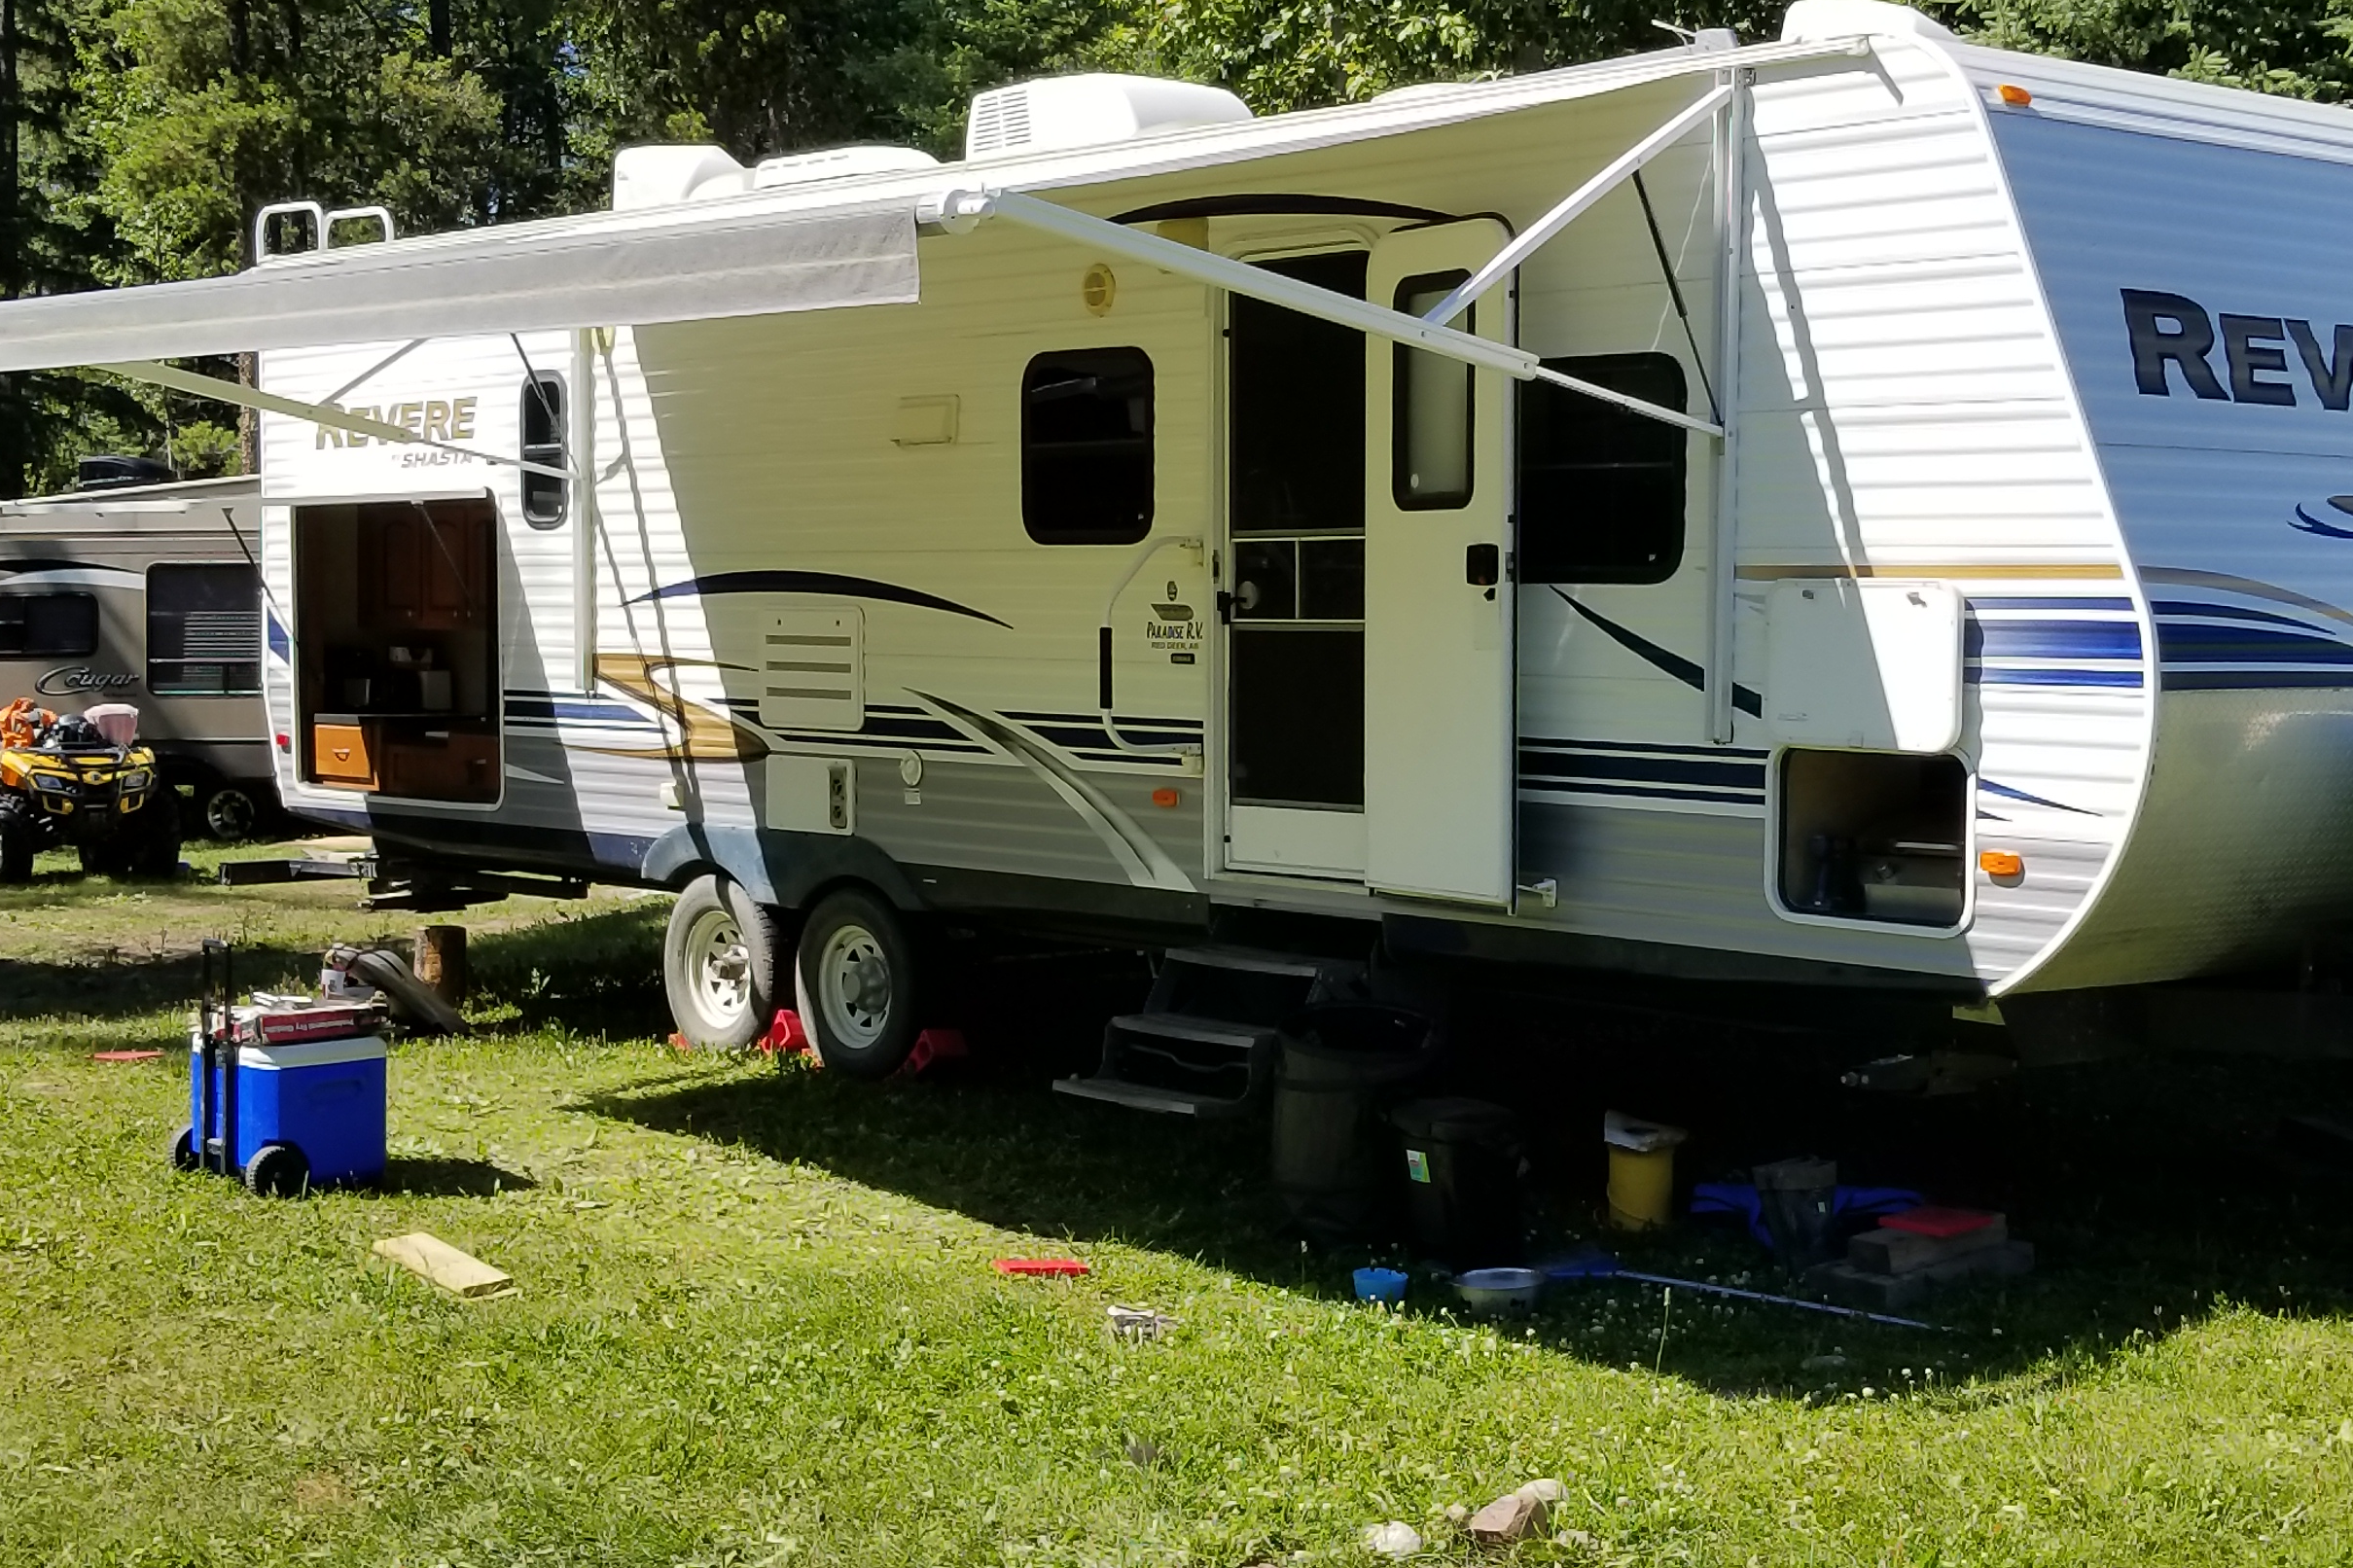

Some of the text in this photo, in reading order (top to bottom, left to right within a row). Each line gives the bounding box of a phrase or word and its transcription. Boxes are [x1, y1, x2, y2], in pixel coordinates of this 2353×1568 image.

[2119, 288, 2353, 411] REV
[1146, 622, 1203, 640] PARADISE R.V.
[35, 665, 139, 696] Cougar
